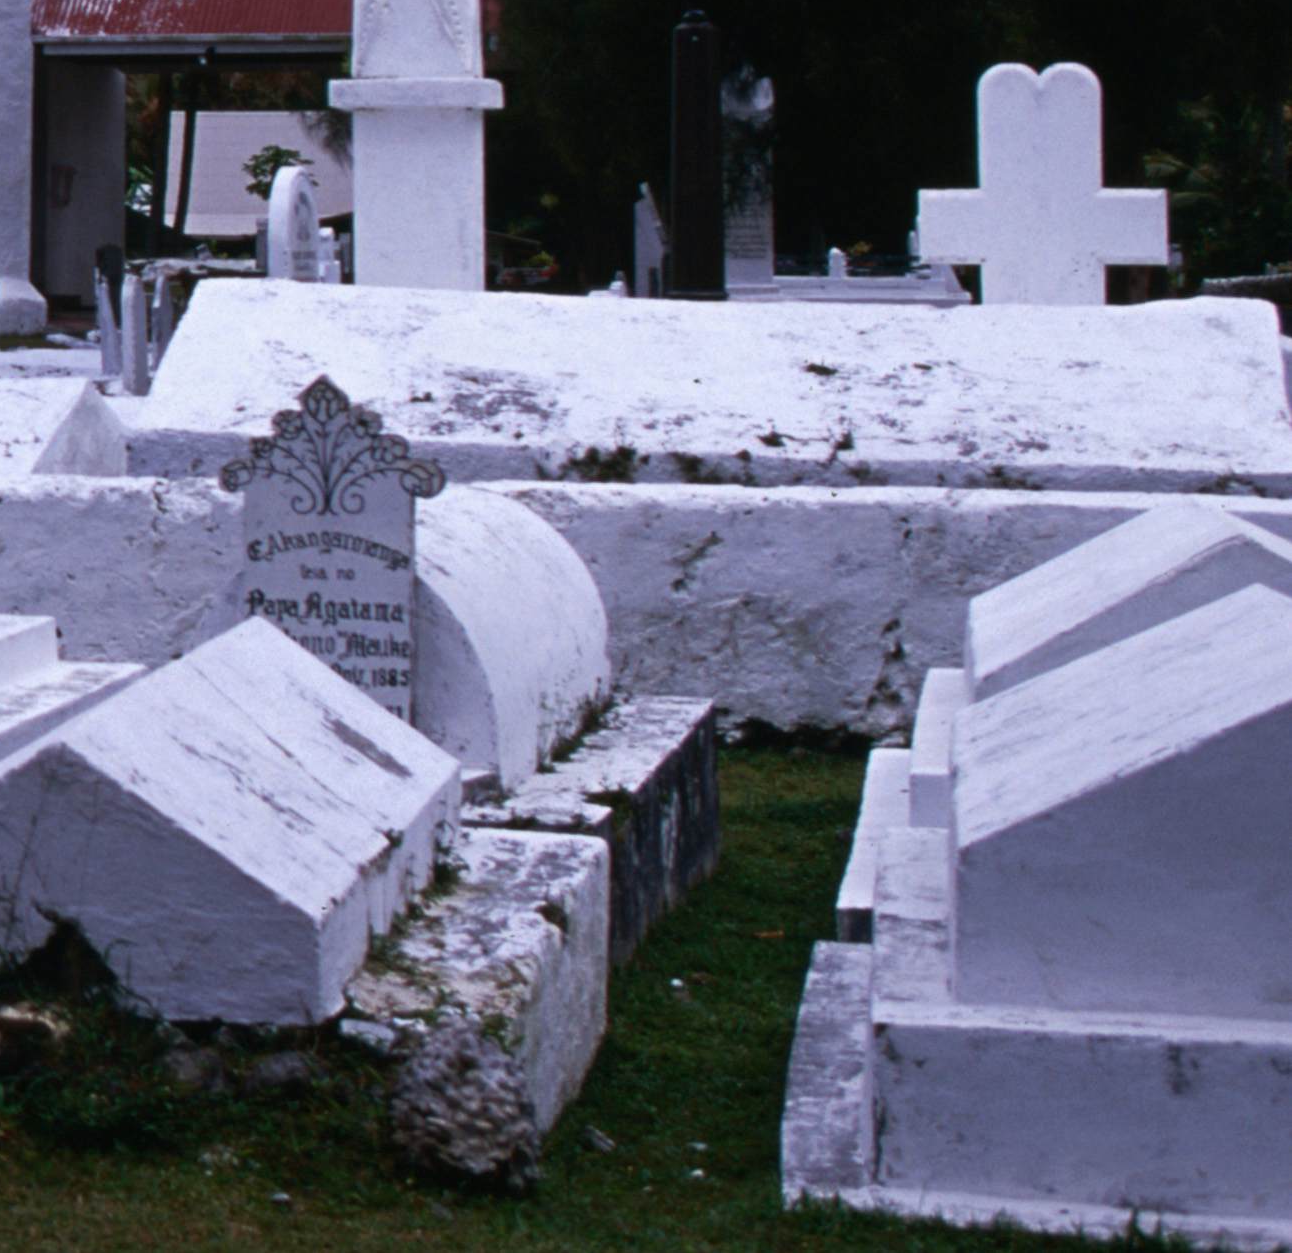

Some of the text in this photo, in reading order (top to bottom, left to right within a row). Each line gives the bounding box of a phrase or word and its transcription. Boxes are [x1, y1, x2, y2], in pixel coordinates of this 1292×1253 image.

[336, 567, 356, 581] no
[246, 589, 299, 622] Papa
[371, 667, 411, 687] 1885
